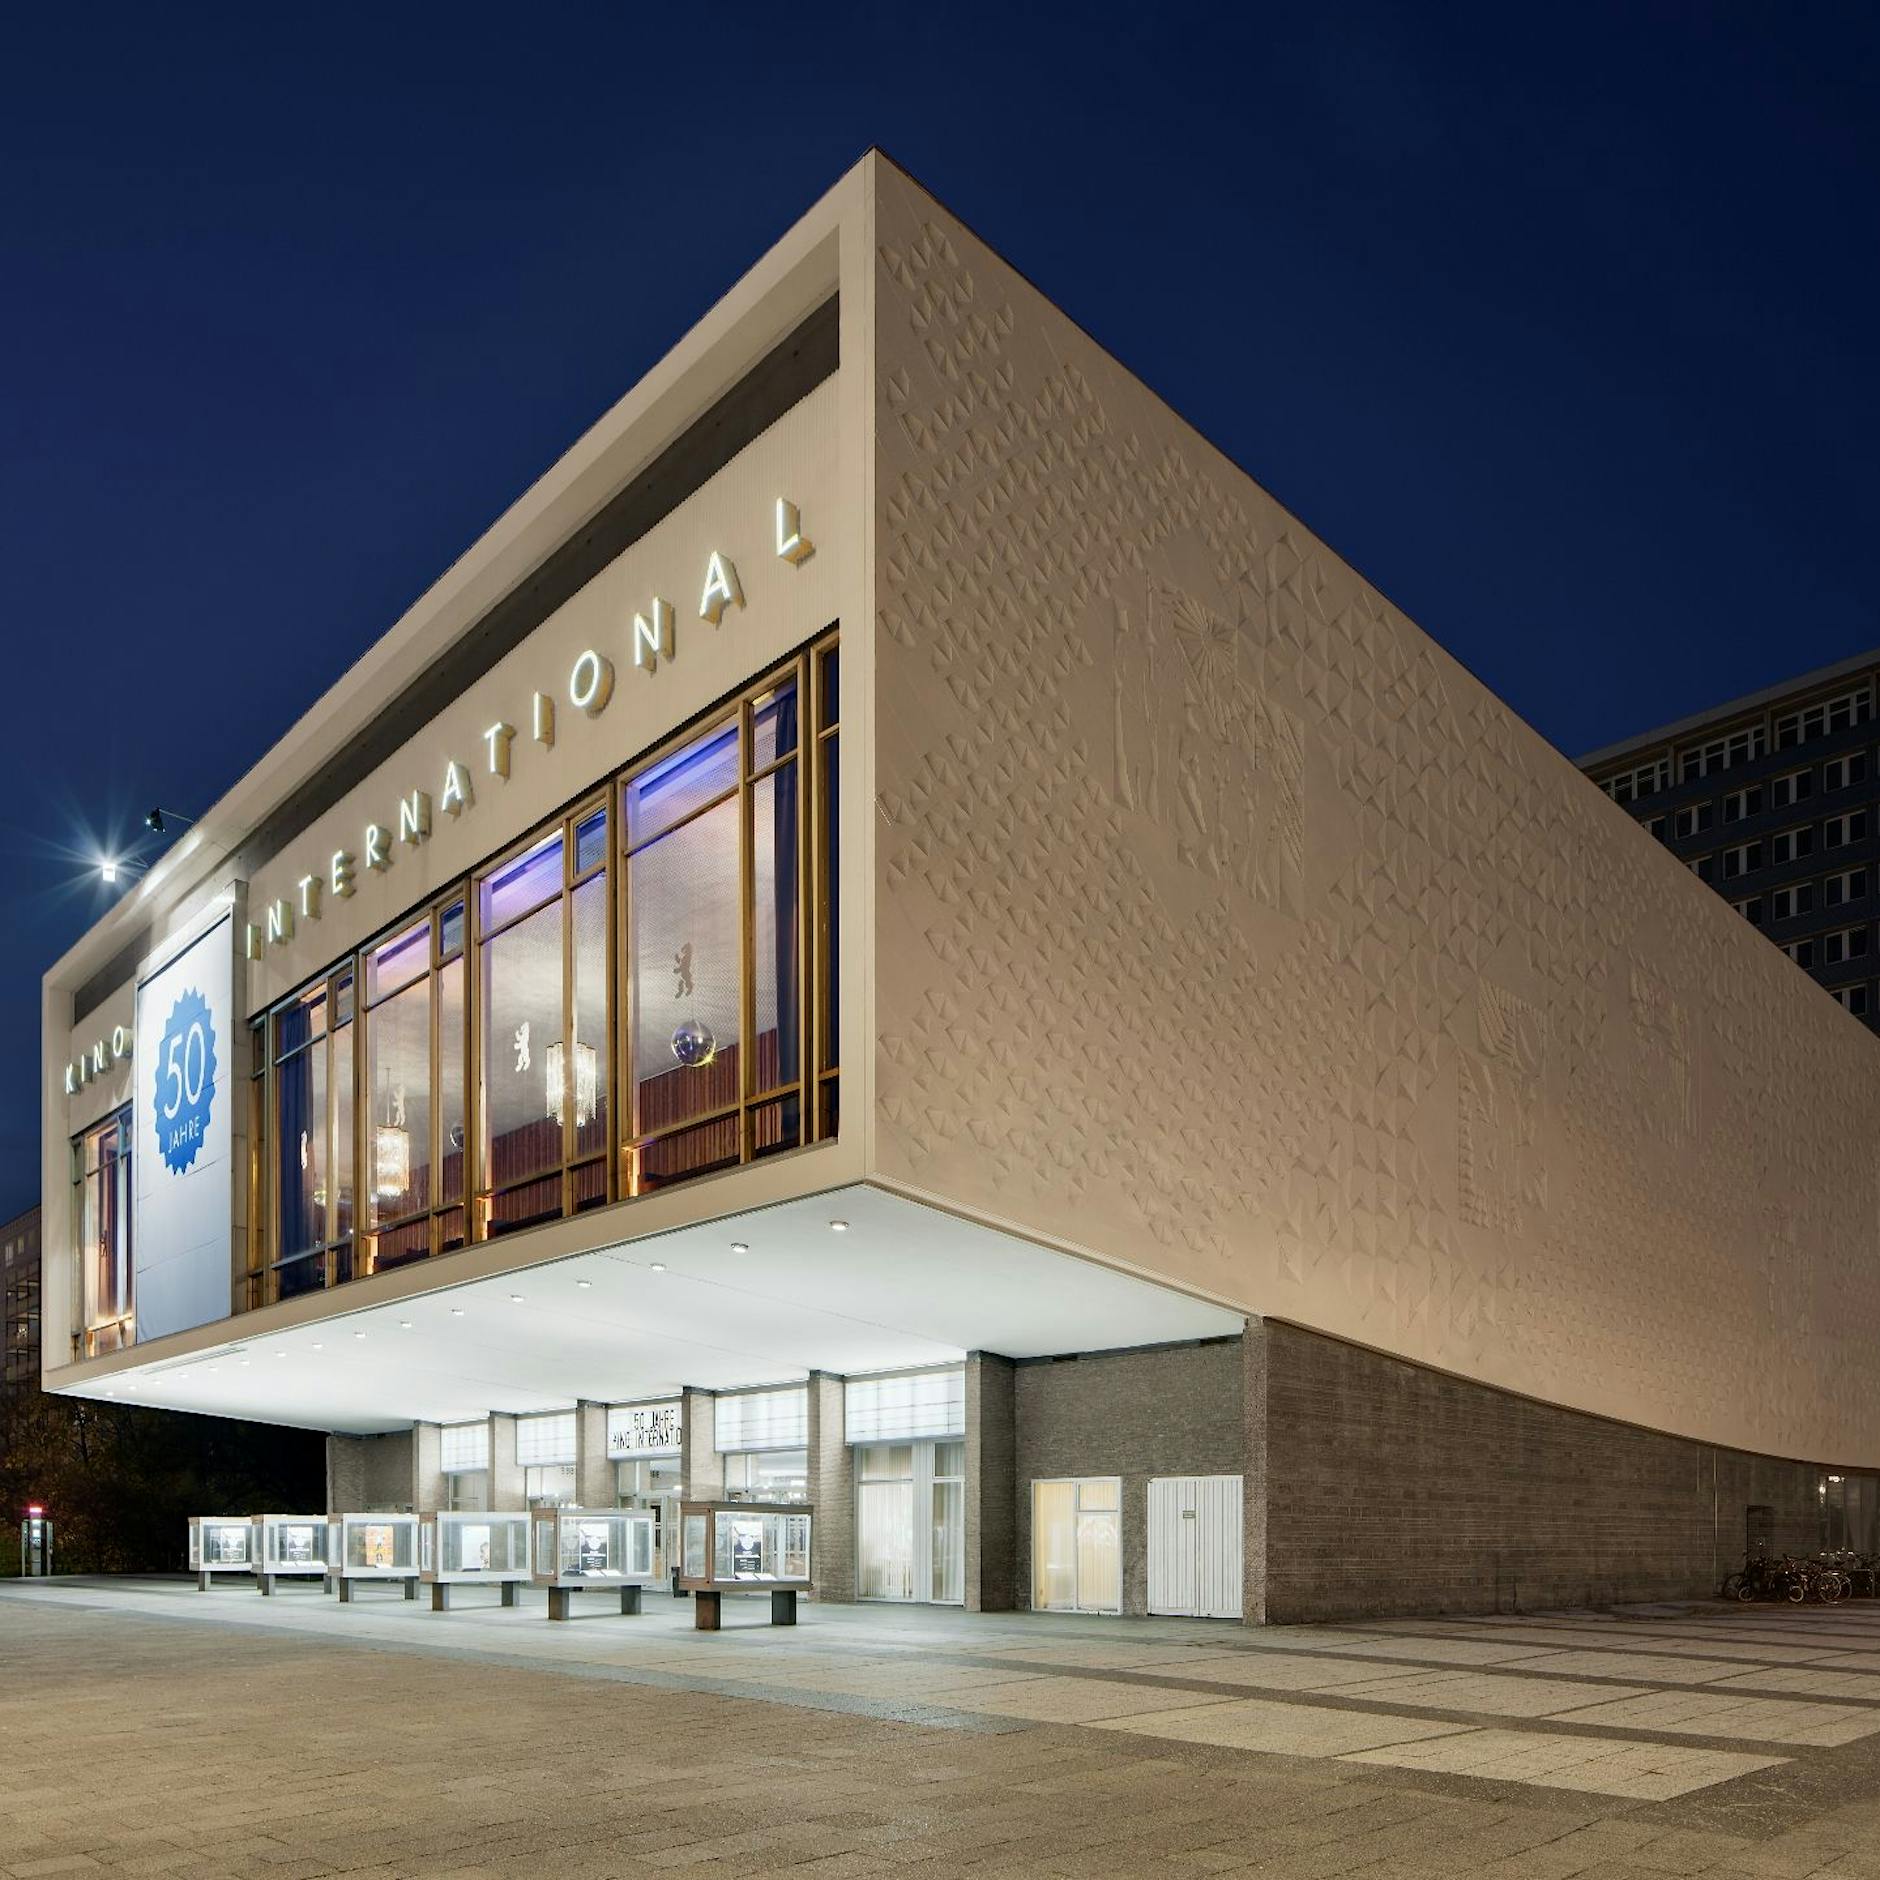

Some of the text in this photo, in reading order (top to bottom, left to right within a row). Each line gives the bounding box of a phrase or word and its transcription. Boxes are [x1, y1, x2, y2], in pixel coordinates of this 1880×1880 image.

[65, 497, 812, 1095] KINO INTERNATIONAL
[164, 1021, 205, 1120] 50
[168, 1116, 200, 1153] JAHRE
